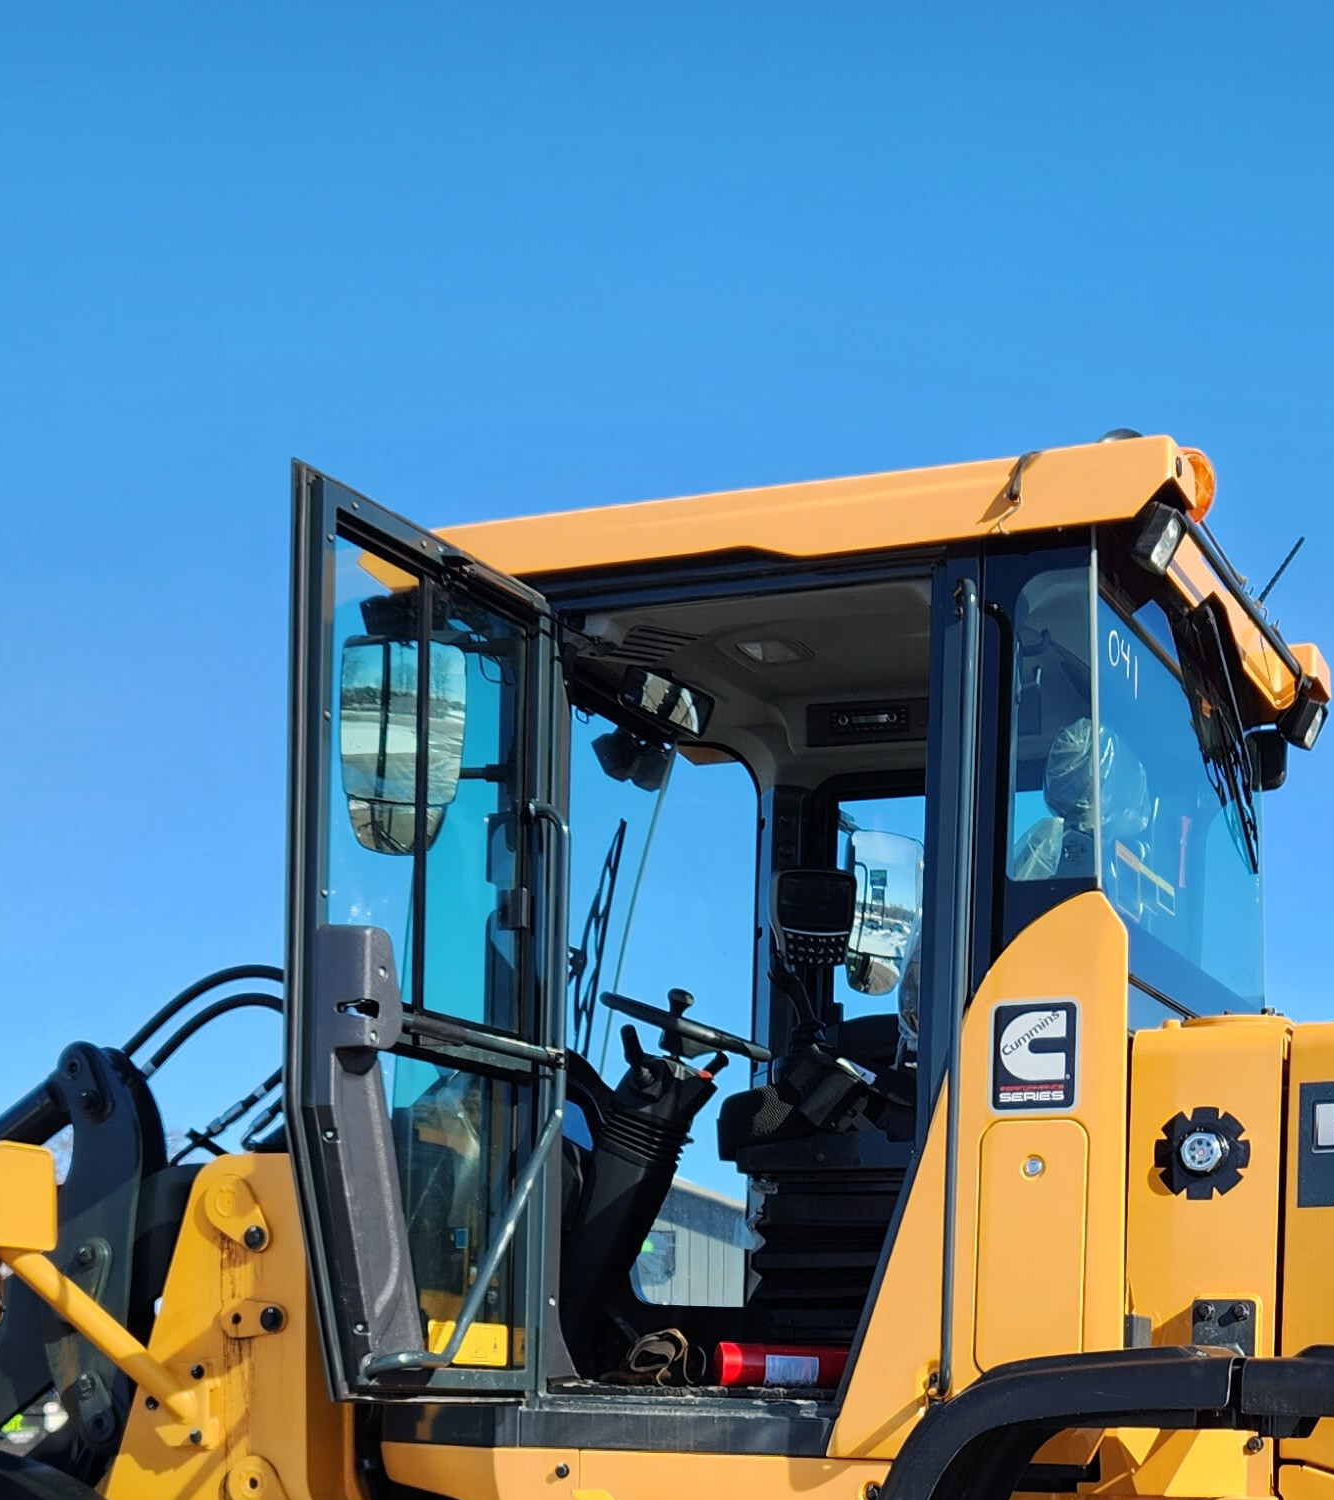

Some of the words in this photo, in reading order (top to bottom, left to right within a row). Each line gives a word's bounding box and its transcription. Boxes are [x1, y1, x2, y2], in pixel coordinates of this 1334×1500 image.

[1108, 629, 1138, 700] 041
[1001, 1011, 1060, 1056] Cummins
[998, 1090, 1065, 1103] SERIES
[999, 1083, 1065, 1092] PERFORMANCE
